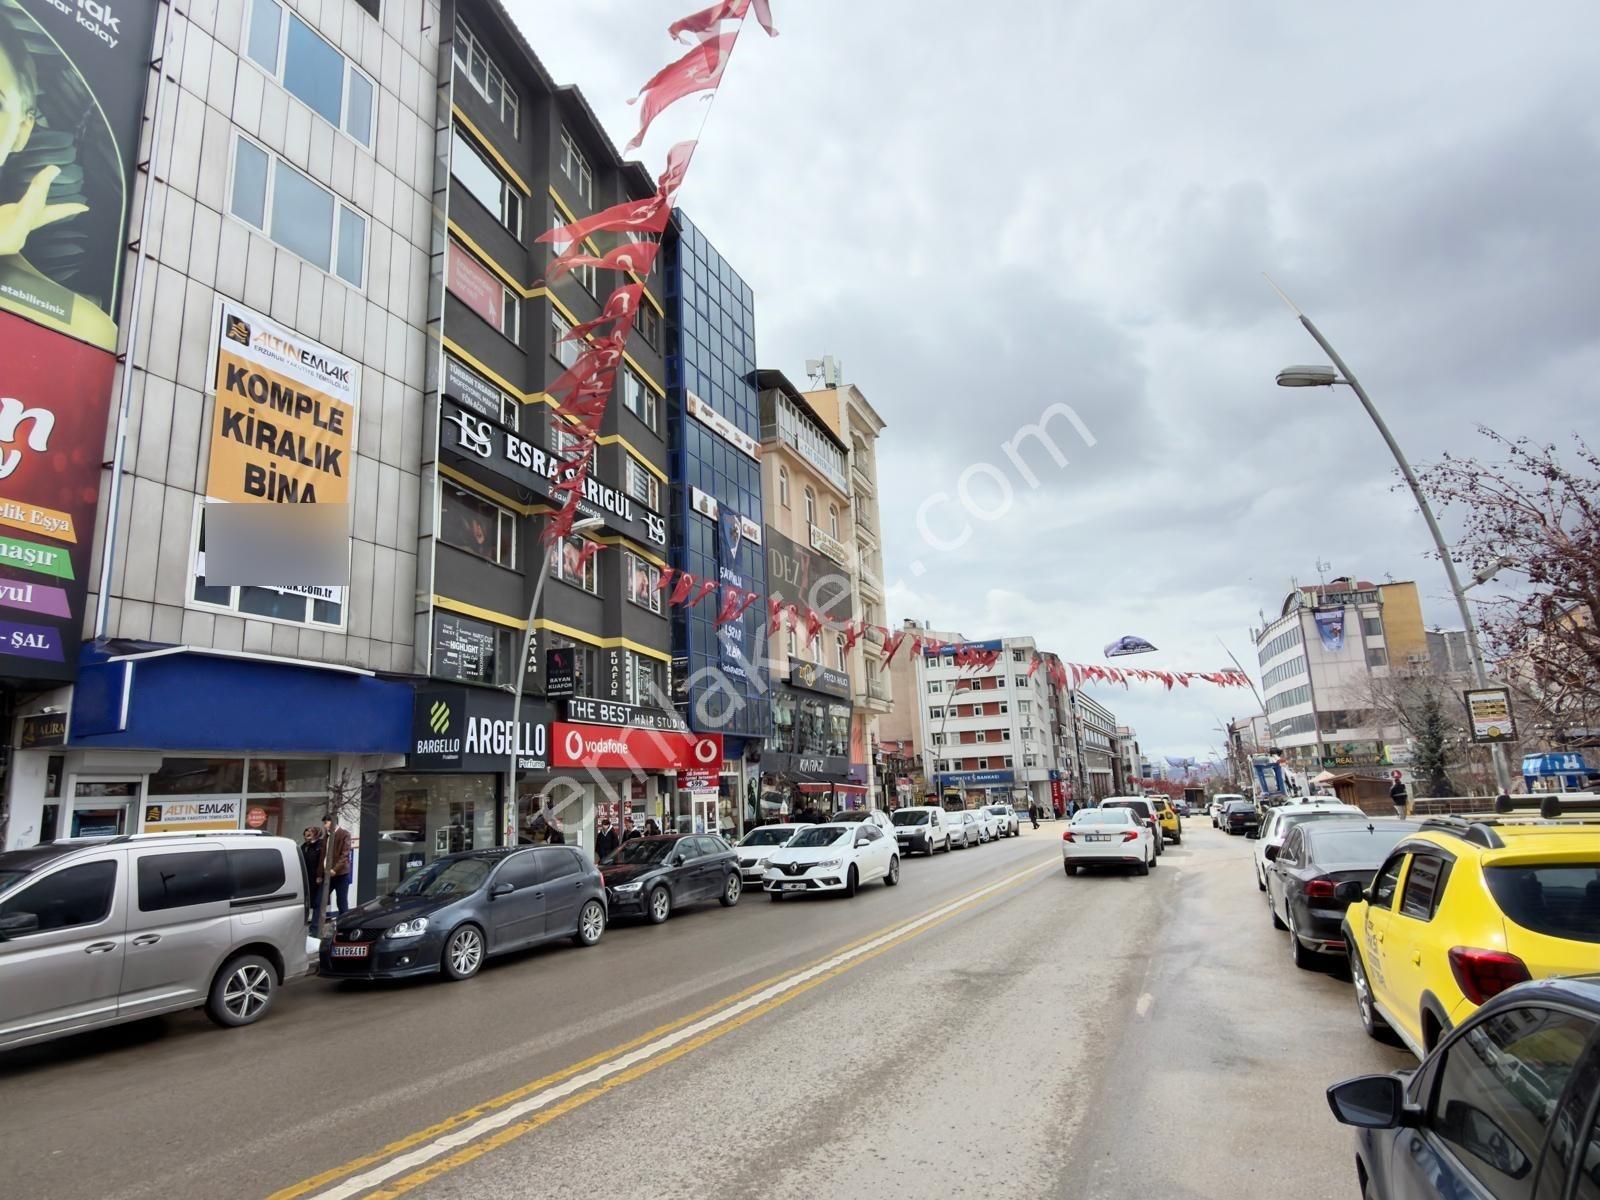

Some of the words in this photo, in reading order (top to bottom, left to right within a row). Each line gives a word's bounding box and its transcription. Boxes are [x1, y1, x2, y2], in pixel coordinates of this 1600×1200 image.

[76, 10, 118, 49] kolay
[226, 362, 344, 436] KOMPLE
[221, 406, 342, 478] KİRALIK
[505, 433, 560, 484] ESRA
[244, 462, 316, 504] BİNA
[31, 509, 70, 532] Eşya
[11, 631, 50, 649] ŞAL
[450, 640, 479, 655] HIGHLIGHT
[527, 628, 538, 674] BAYAN
[548, 682, 573, 690] KUAFÖR
[610, 651, 619, 697] KUAFÖR
[569, 700, 596, 719] THE
[600, 704, 632, 725] BEST
[635, 713, 654, 727] HAIR
[658, 717, 685, 730] STUDIO
[417, 738, 460, 754] BARGELLO
[465, 716, 546, 756] ARGELLO
[585, 738, 629, 754] vodafone
[518, 757, 545, 769] Perfume
[800, 758, 824, 773] KARAZ
[164, 803, 235, 816] ALTINEMLAK
